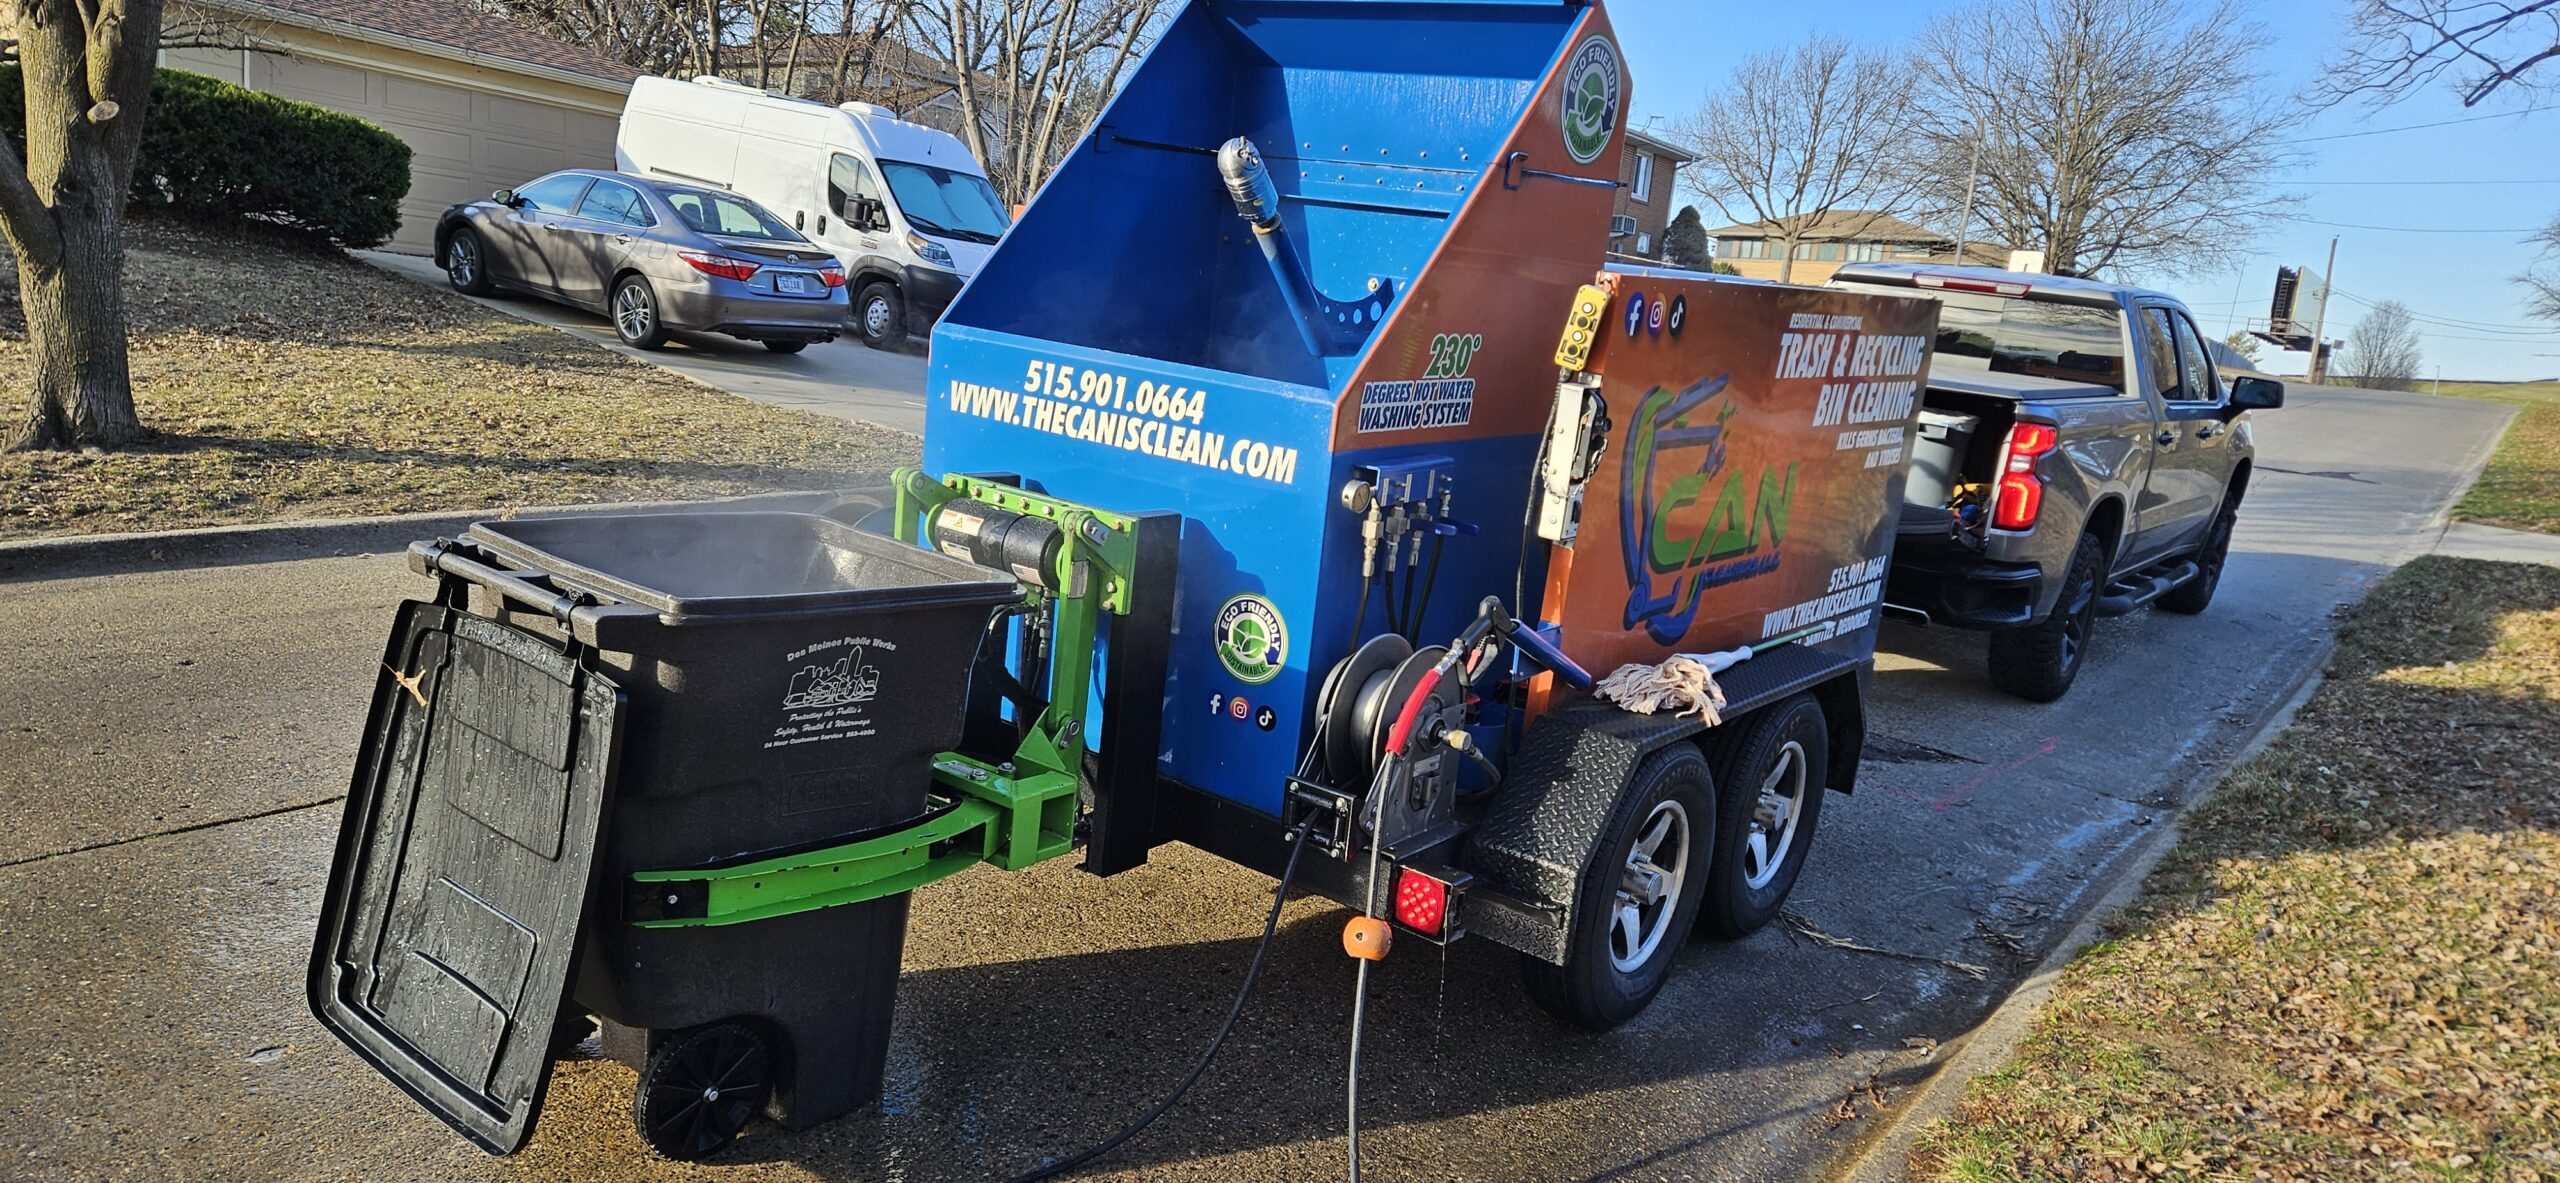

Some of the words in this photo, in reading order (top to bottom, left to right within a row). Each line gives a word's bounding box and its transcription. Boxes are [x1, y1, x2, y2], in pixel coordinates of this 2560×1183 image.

[1569, 56, 1587, 94] ECO
[1588, 47, 1617, 110] FRIENDLY
[1789, 312, 1825, 330] RESIDENTIAL
[1824, 314, 1831, 330] &
[1830, 315, 1864, 331] COMMERCIAL
[1775, 333, 1836, 379] TRASH
[1832, 334, 1851, 378] &
[1849, 334, 1926, 377] RECYCLING
[1023, 359, 1207, 425] 515.901.0664
[1362, 381, 1415, 405] DEGREES
[1412, 380, 1439, 402] HOT
[1437, 379, 1475, 401] WATER
[1812, 383, 1851, 427] BIN
[1848, 380, 1917, 424] CLEANING
[1358, 404, 1422, 431] WASHING
[1421, 401, 1473, 426] SYSTEM
[950, 379, 1298, 485] WWW.THECANISCLEAN.COM
[1836, 431, 1857, 451] KILLS
[1855, 429, 1879, 448] GERMS
[1864, 450, 1880, 469] AND
[1877, 447, 1903, 467] VIRUSES
[1650, 462, 1799, 575] CAN
[1828, 555, 1887, 593] 515.901.0664
[1762, 579, 1882, 639] WWW.THECANISCLEAN.COM
[1836, 608, 1873, 637] DEODORIZE
[1221, 605, 1238, 631] ECO
[1240, 601, 1280, 652] FRIENDLY
[787, 649, 806, 662] Des
[808, 639, 842, 654] Moines
[844, 636, 871, 646] Public
[872, 638, 897, 651] Works
[1225, 650, 1266, 676] SUSTAINABLE
[788, 711, 823, 722] Protecting
[824, 708, 834, 717] the
[835, 706, 862, 717] Public's
[802, 722, 826, 732] Health
[826, 721, 833, 729] &
[834, 719, 871, 729] Waterways
[773, 740, 788, 748] Hour
[789, 736, 820, 745] Customer
[820, 732, 843, 741] Service
